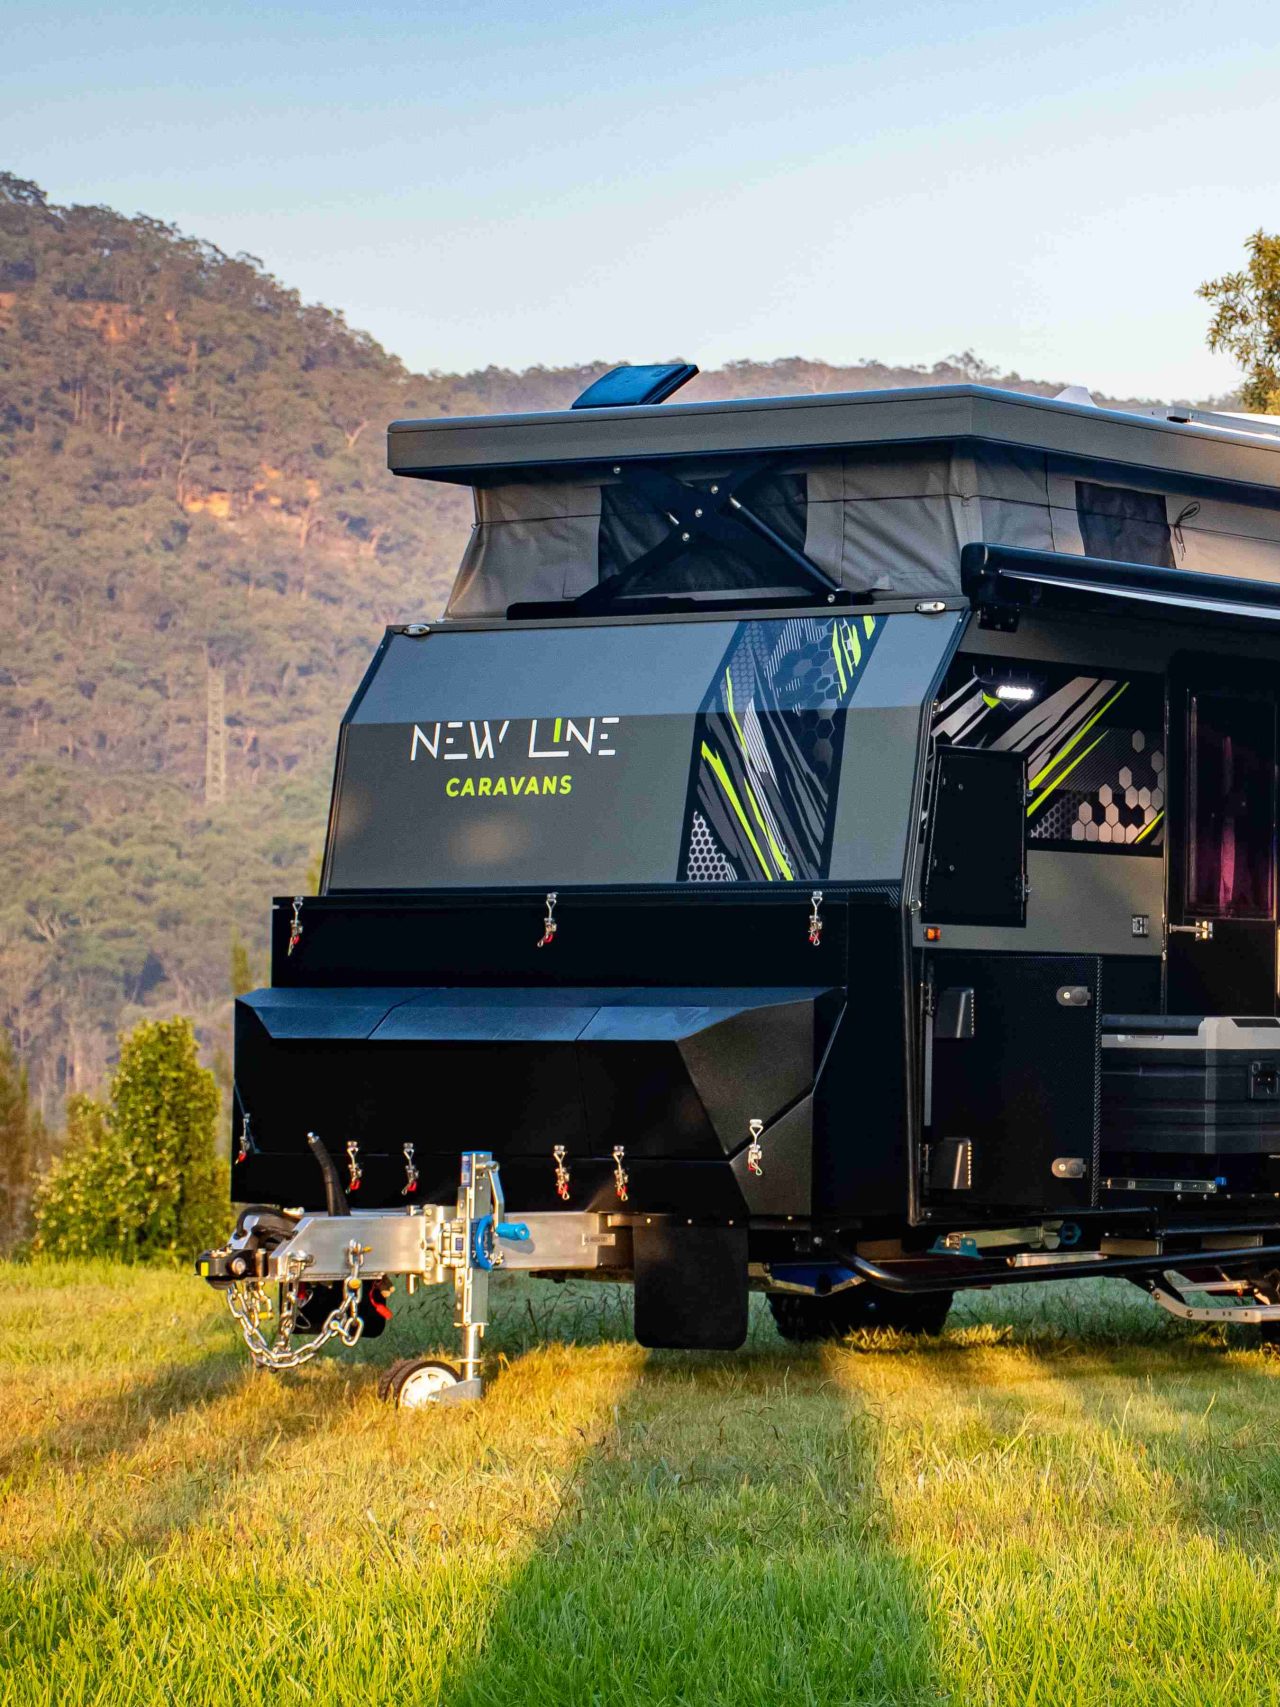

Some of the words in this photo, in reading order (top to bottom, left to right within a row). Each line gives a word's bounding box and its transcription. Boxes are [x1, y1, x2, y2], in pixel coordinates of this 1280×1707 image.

[410, 720, 510, 761] NEW
[528, 716, 620, 758] LINE
[445, 774, 573, 797] CARAVANS
